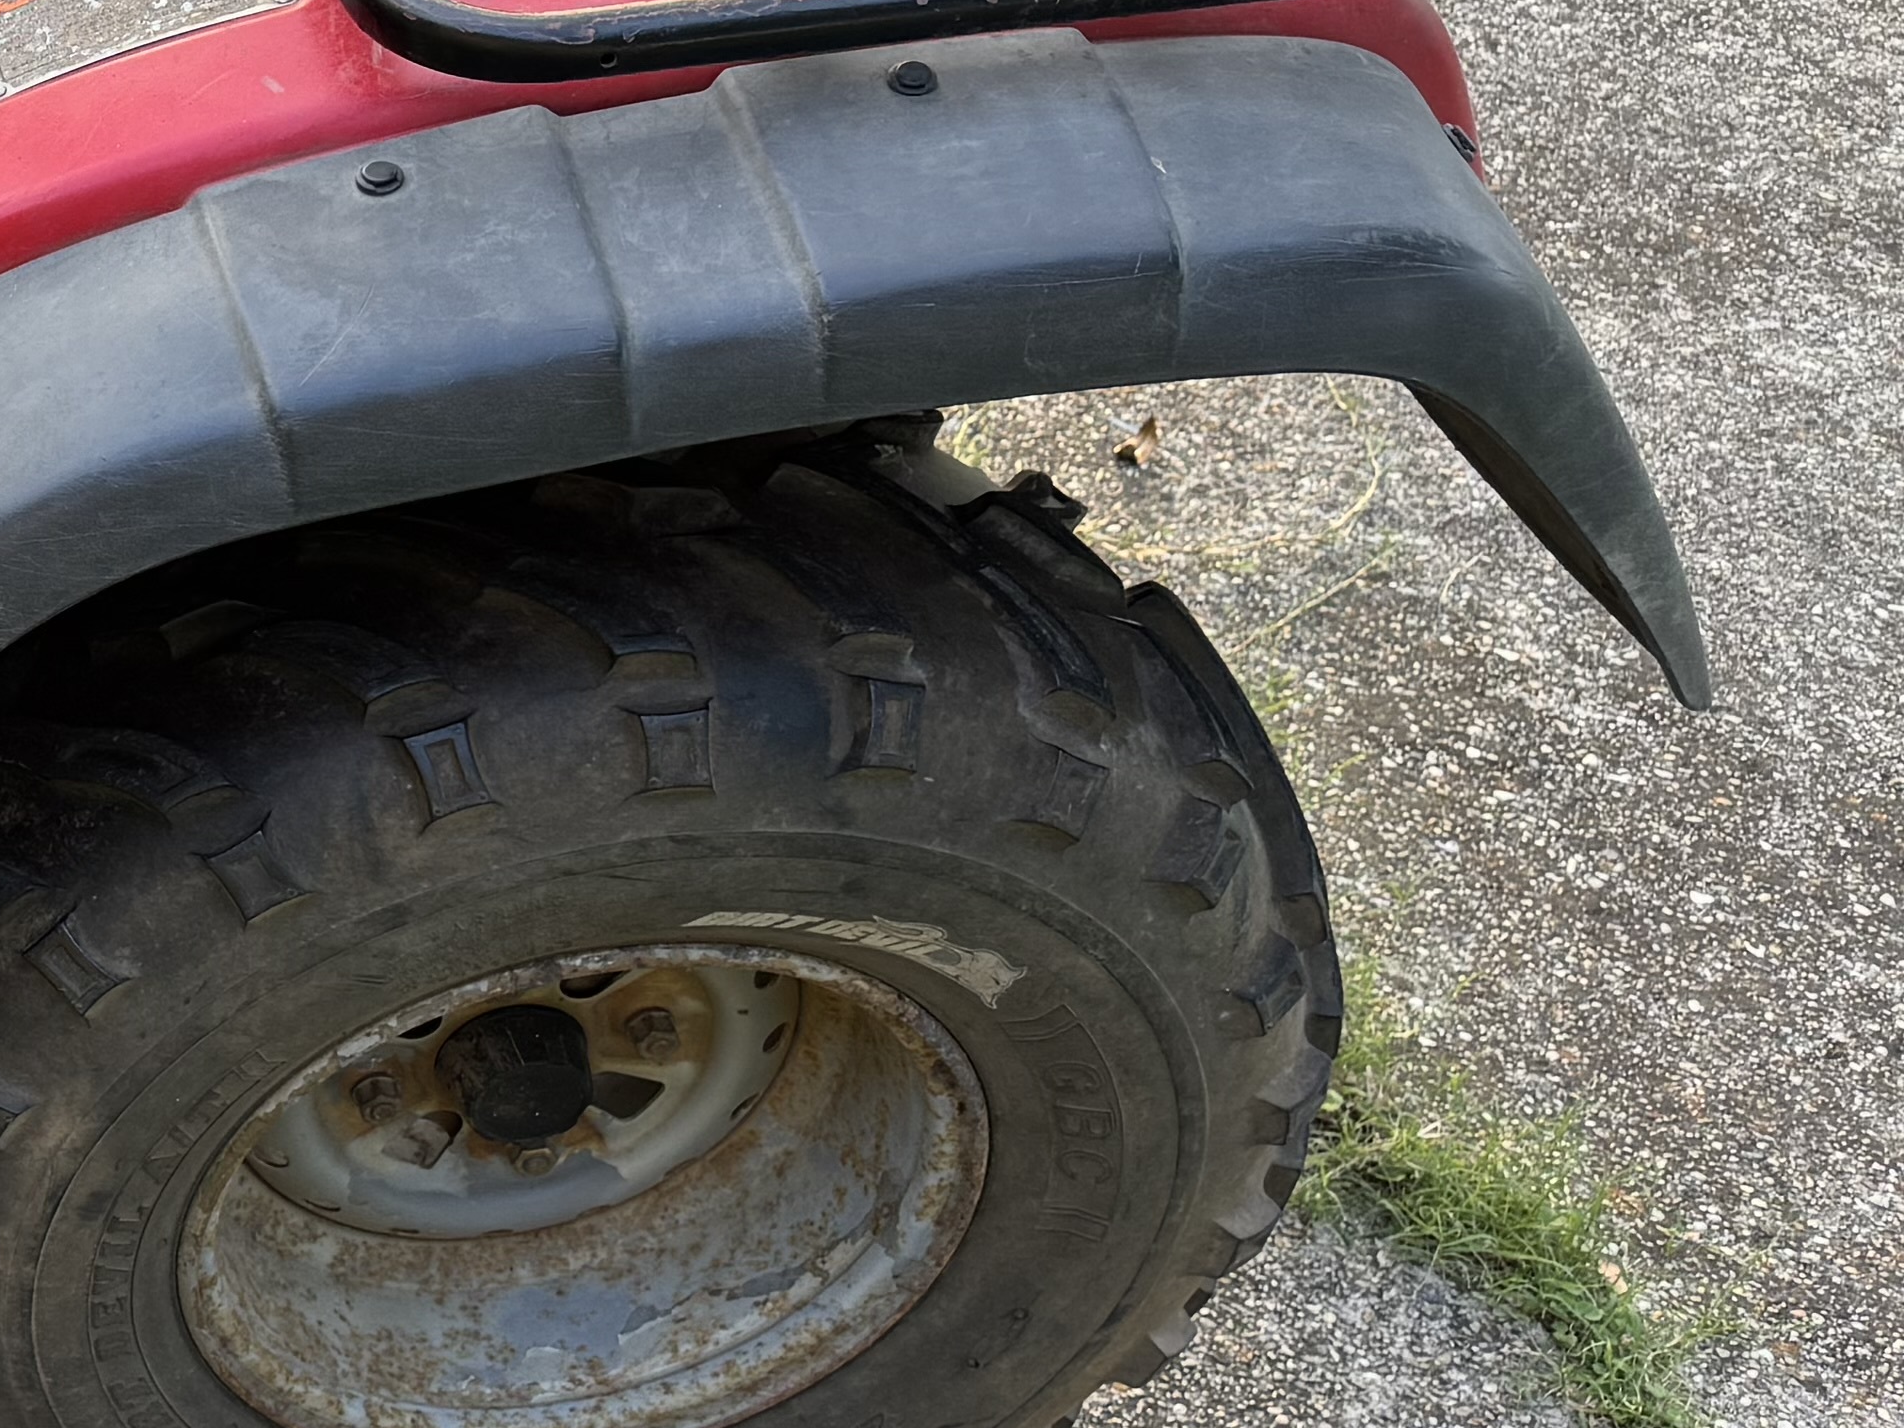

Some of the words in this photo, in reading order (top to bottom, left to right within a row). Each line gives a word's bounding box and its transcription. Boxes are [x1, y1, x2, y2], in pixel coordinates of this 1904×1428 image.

[803, 919, 949, 964] DEVIL
[1042, 1061, 1116, 1185] GBC
[91, 1204, 152, 1362] DEVIL
